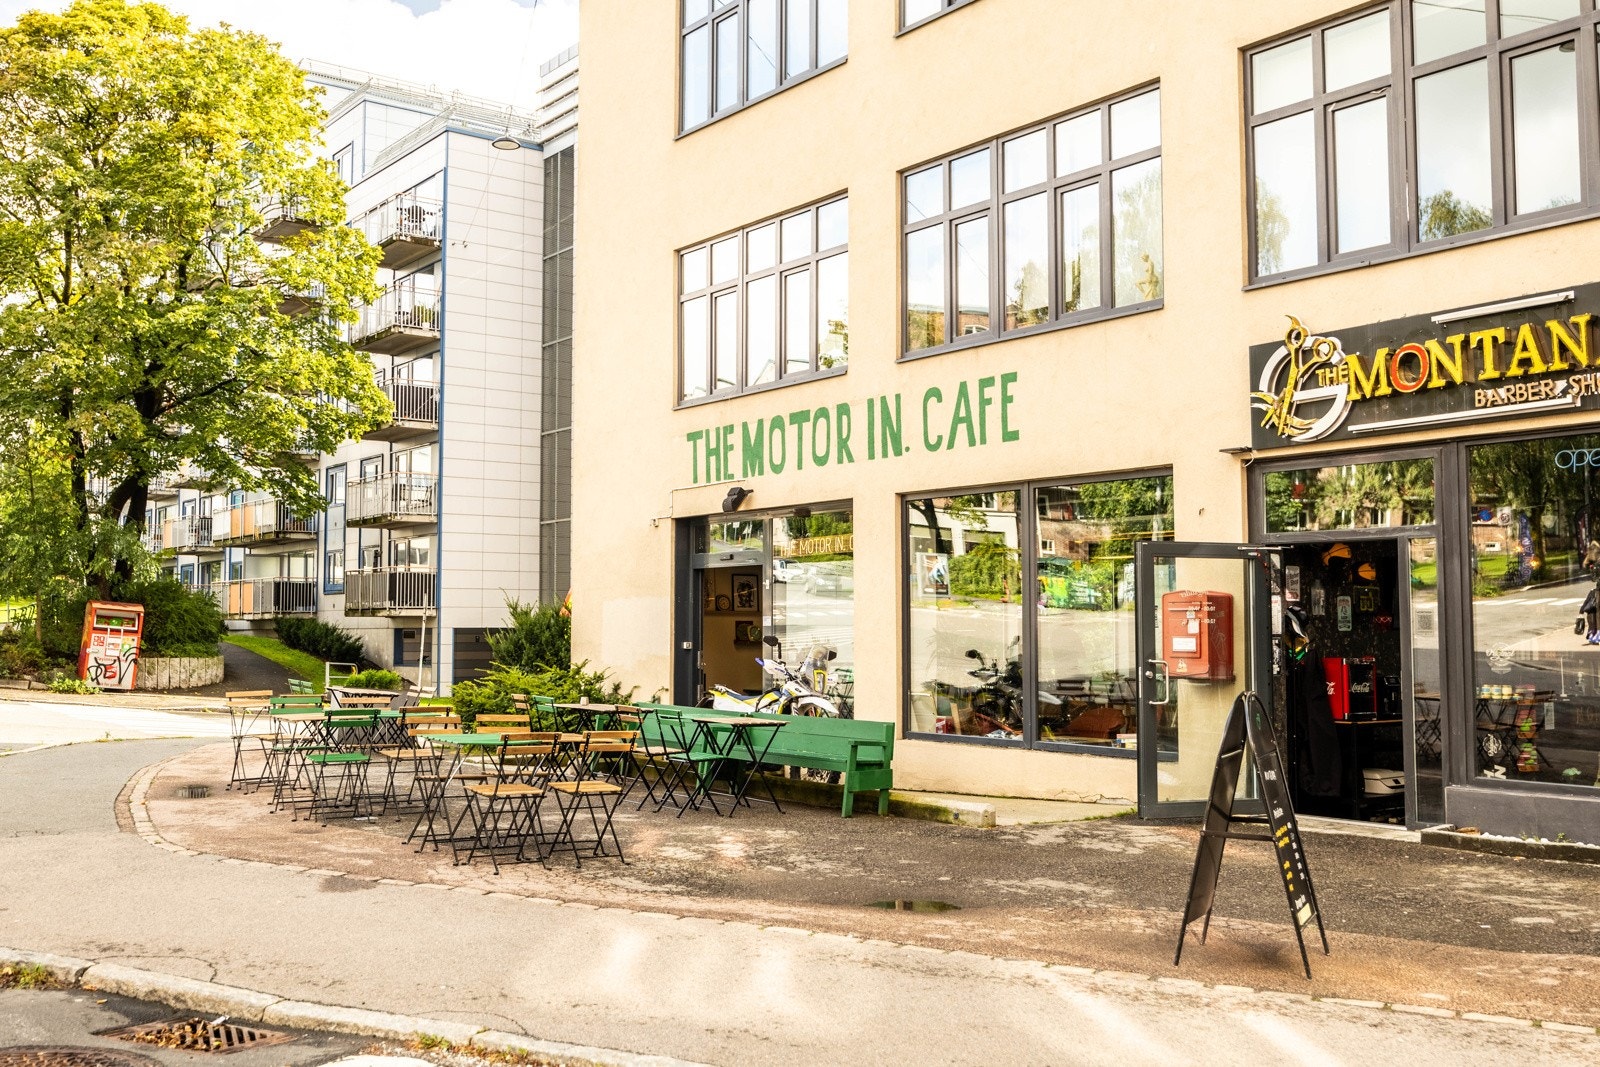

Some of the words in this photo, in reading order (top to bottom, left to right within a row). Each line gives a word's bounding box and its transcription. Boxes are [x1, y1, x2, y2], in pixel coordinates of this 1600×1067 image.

[1315, 360, 1349, 388] THE
[1346, 312, 1600, 401] MONTAN
[1474, 378, 1556, 408] BARBER
[686, 423, 735, 484] THE
[741, 402, 855, 479] MOTOR
[866, 393, 911, 461] IN.
[922, 371, 1020, 452] CAFE
[780, 539, 798, 557] THE
[799, 538, 832, 555] MOTOR
